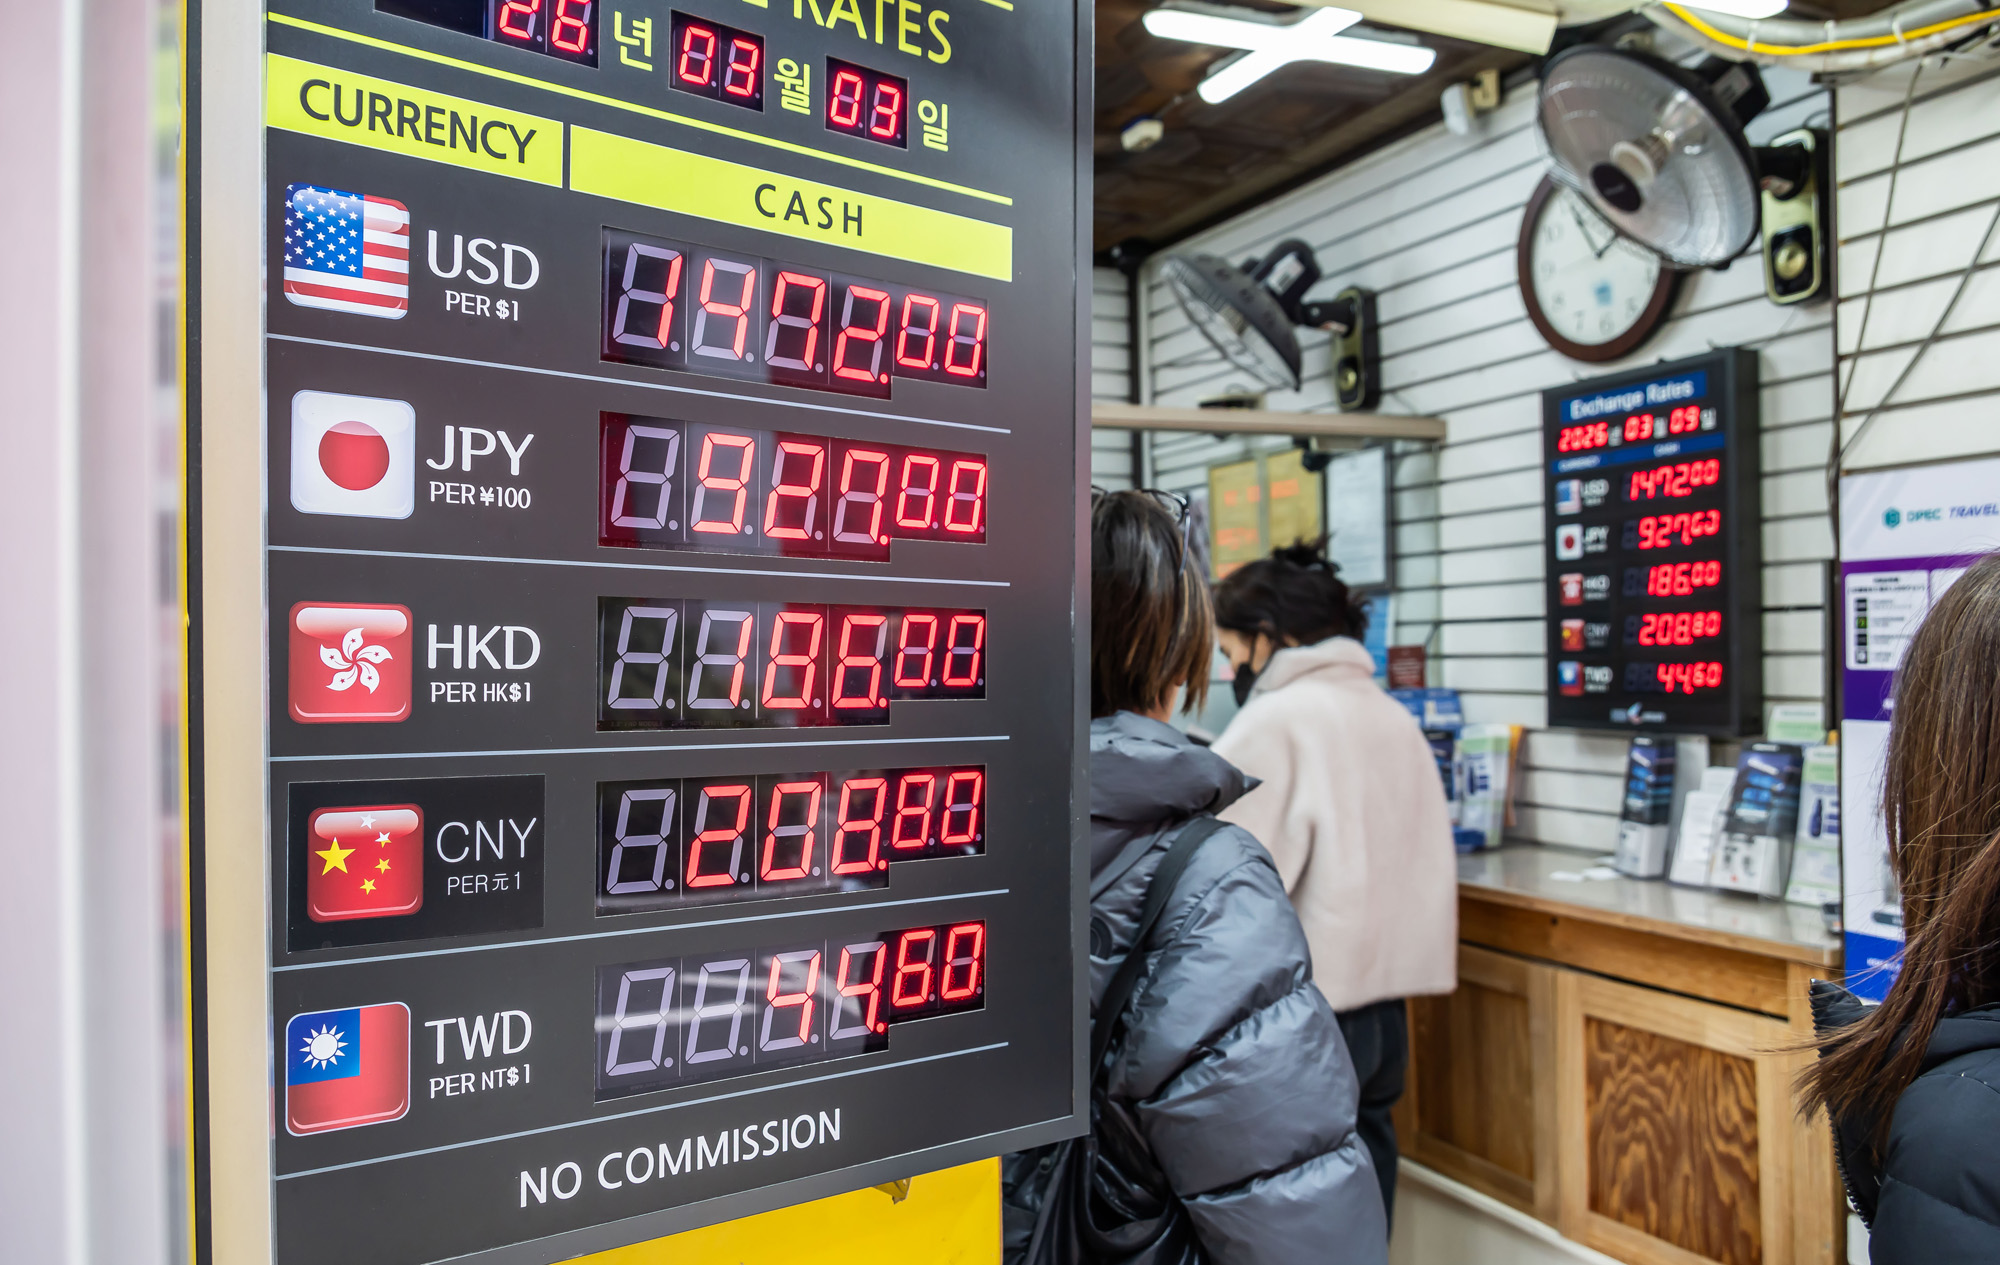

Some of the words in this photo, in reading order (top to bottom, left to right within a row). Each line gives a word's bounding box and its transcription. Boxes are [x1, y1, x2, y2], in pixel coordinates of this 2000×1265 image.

[614, 11, 652, 71] 년
[678, 26, 759, 97] 03
[774, 58, 810, 116] 월
[829, 71, 901, 138] 03
[917, 99, 949, 152] 일
[299, 78, 537, 164] CURRENCY
[754, 183, 865, 238] CASH
[427, 229, 540, 290] USD
[444, 289, 491, 318] PER
[495, 298, 519, 322] $1
[426, 425, 535, 476] JPY
[1558, 422, 1608, 452] 2026
[1624, 414, 1654, 441] 03
[429, 481, 476, 505] PER
[480, 486, 531, 509] ¥100
[1948, 503, 1999, 519] TRAVEL
[427, 623, 541, 670] HKD
[430, 682, 476, 702] PER
[483, 682, 531, 702] HK$1
[436, 817, 537, 863] CNY
[447, 874, 488, 896] PER
[424, 1010, 532, 1065] TWD
[429, 1072, 475, 1099] PER
[520, 1161, 582, 1208] NO
[597, 1107, 841, 1189] COMMISSION
